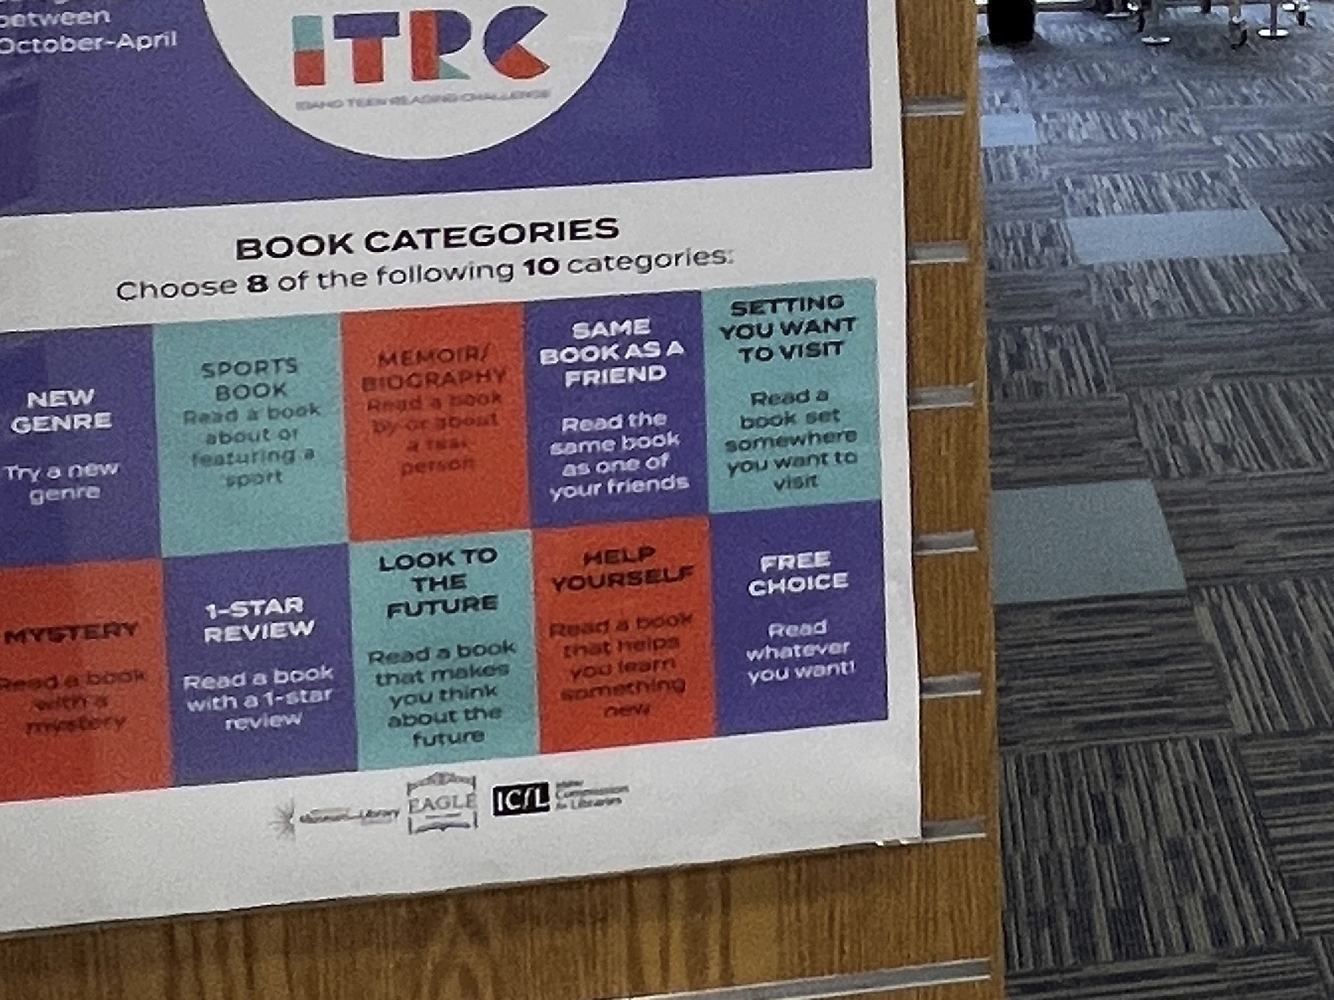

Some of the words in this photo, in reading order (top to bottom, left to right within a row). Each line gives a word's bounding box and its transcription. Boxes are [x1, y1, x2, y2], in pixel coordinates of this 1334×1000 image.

[291, 5, 551, 87] ITRC
[347, 97, 388, 108] TEEN
[236, 232, 355, 261] BOOK
[365, 217, 619, 253] CATEGORIES
[116, 279, 237, 301] Choose
[247, 274, 269, 293] 8
[277, 270, 310, 291] of
[318, 268, 367, 290] the
[377, 260, 514, 286] following
[523, 257, 560, 276] 10
[731, 294, 845, 317] SETTING
[572, 317, 651, 340] SAME
[719, 323, 774, 340] YOU
[780, 316, 857, 336] WANT
[378, 343, 491, 366] MEMOIR/
[539, 343, 620, 366] BOOK
[624, 341, 662, 360] AS
[666, 341, 685, 357] A
[739, 346, 774, 364] TO
[779, 341, 845, 360] VISIT
[201, 357, 298, 379] SPORTS
[362, 367, 506, 392] BIOGRAPHY
[565, 365, 667, 388] FRIEND
[27, 389, 95, 409] NEW
[215, 382, 287, 401] BOOK
[751, 388, 810, 406] Read
[816, 389, 829, 401] a
[11, 412, 113, 434] GENRE
[183, 408, 238, 425] Read
[267, 402, 321, 420] book
[562, 414, 623, 434] Read
[628, 411, 667, 428] the
[740, 411, 796, 430] book
[805, 408, 840, 425] set
[206, 428, 270, 445] about
[550, 438, 616, 455] same
[621, 431, 680, 450] book
[725, 430, 858, 453] somewhere
[192, 449, 296, 466] featuring
[401, 458, 475, 476] person
[562, 462, 591, 477] as
[596, 458, 640, 474] one
[645, 452, 670, 470] of
[727, 459, 768, 479] you
[774, 452, 828, 469] want
[834, 451, 858, 465] to
[4, 464, 41, 482] Try
[47, 465, 61, 479] a
[68, 462, 120, 478] new
[226, 470, 283, 488] sport
[774, 474, 819, 491] visit
[30, 486, 101, 505] genre
[550, 482, 602, 502] your
[607, 474, 690, 494] friends
[379, 551, 456, 572] LOOK
[461, 547, 498, 564] TO
[583, 546, 656, 566] HELP
[761, 551, 831, 574] FREE
[411, 573, 467, 592] THE
[552, 565, 694, 593] YOURSELF
[748, 572, 849, 597] CHOICE
[205, 596, 304, 620] 1-STAR
[387, 595, 499, 619] FUTURE
[4, 621, 138, 645] MYSTERY
[204, 620, 315, 644] REVIEW
[550, 619, 610, 638] Read
[615, 620, 629, 632] a
[636, 613, 693, 630] book
[768, 619, 827, 639] Read
[368, 647, 430, 665] Read
[436, 648, 450, 660] a
[456, 639, 517, 658] book
[563, 641, 611, 659] that
[617, 637, 680, 653] helps
[746, 641, 851, 661] whatever
[86, 669, 145, 686] book
[183, 671, 246, 690] Read
[252, 672, 267, 686] a
[273, 664, 334, 684] book
[375, 669, 424, 687] that
[431, 663, 510, 682] makes
[570, 664, 612, 682] you
[618, 658, 676, 674] learn
[747, 666, 790, 686] you
[794, 660, 856, 678] want!
[187, 695, 237, 712] with
[243, 695, 258, 709] a
[264, 688, 333, 707] 1-star
[389, 691, 433, 710] you
[438, 685, 498, 702] think
[560, 678, 686, 702] something
[225, 712, 302, 731] review
[387, 710, 458, 728] about
[464, 707, 502, 721] the
[603, 704, 651, 718] new
[26, 715, 126, 736] mystery
[412, 730, 485, 748] future
[408, 793, 478, 814] EAGLE
